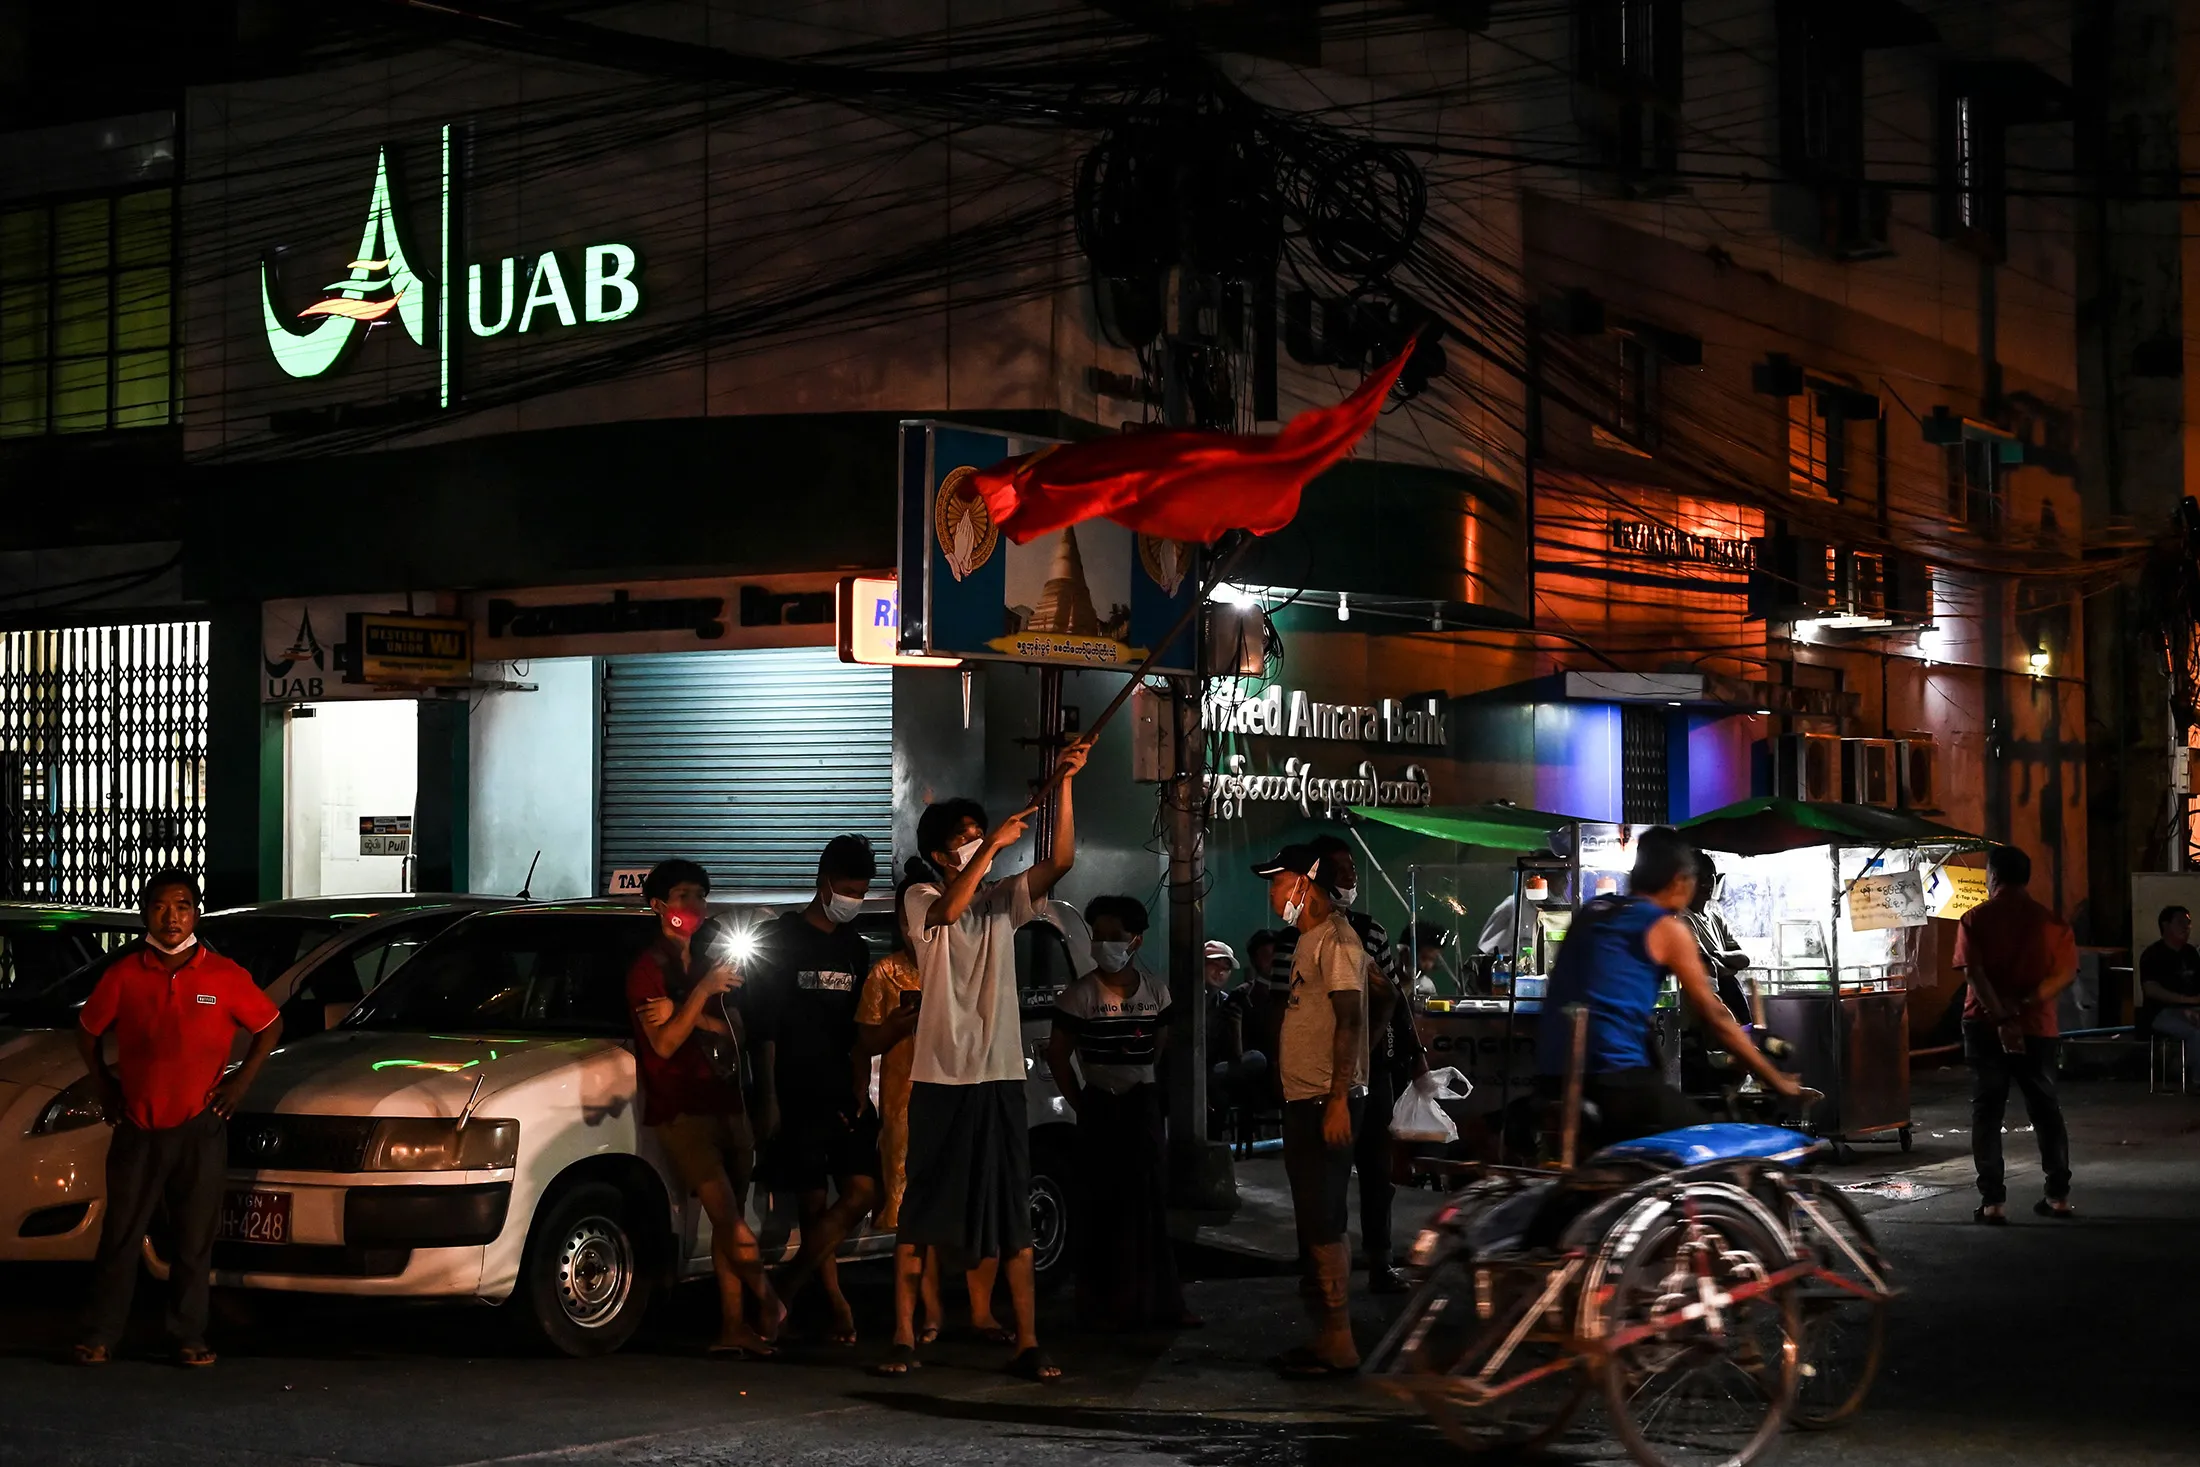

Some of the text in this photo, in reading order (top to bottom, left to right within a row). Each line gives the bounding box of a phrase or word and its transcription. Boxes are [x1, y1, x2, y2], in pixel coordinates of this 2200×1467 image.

[468, 243, 640, 337] UAB
[369, 627, 461, 656] WESTERN WU
[386, 641, 424, 655] UNION
[269, 678, 324, 698] UAB
[1288, 690, 1379, 743] Amara
[1383, 698, 1448, 747] Bank
[387, 840, 406, 852] Pull
[1092, 1003, 1118, 1013] Hello
[1120, 1003, 1136, 1014] My
[236, 1193, 263, 1209] YGN
[219, 1209, 284, 1240] H-4248
